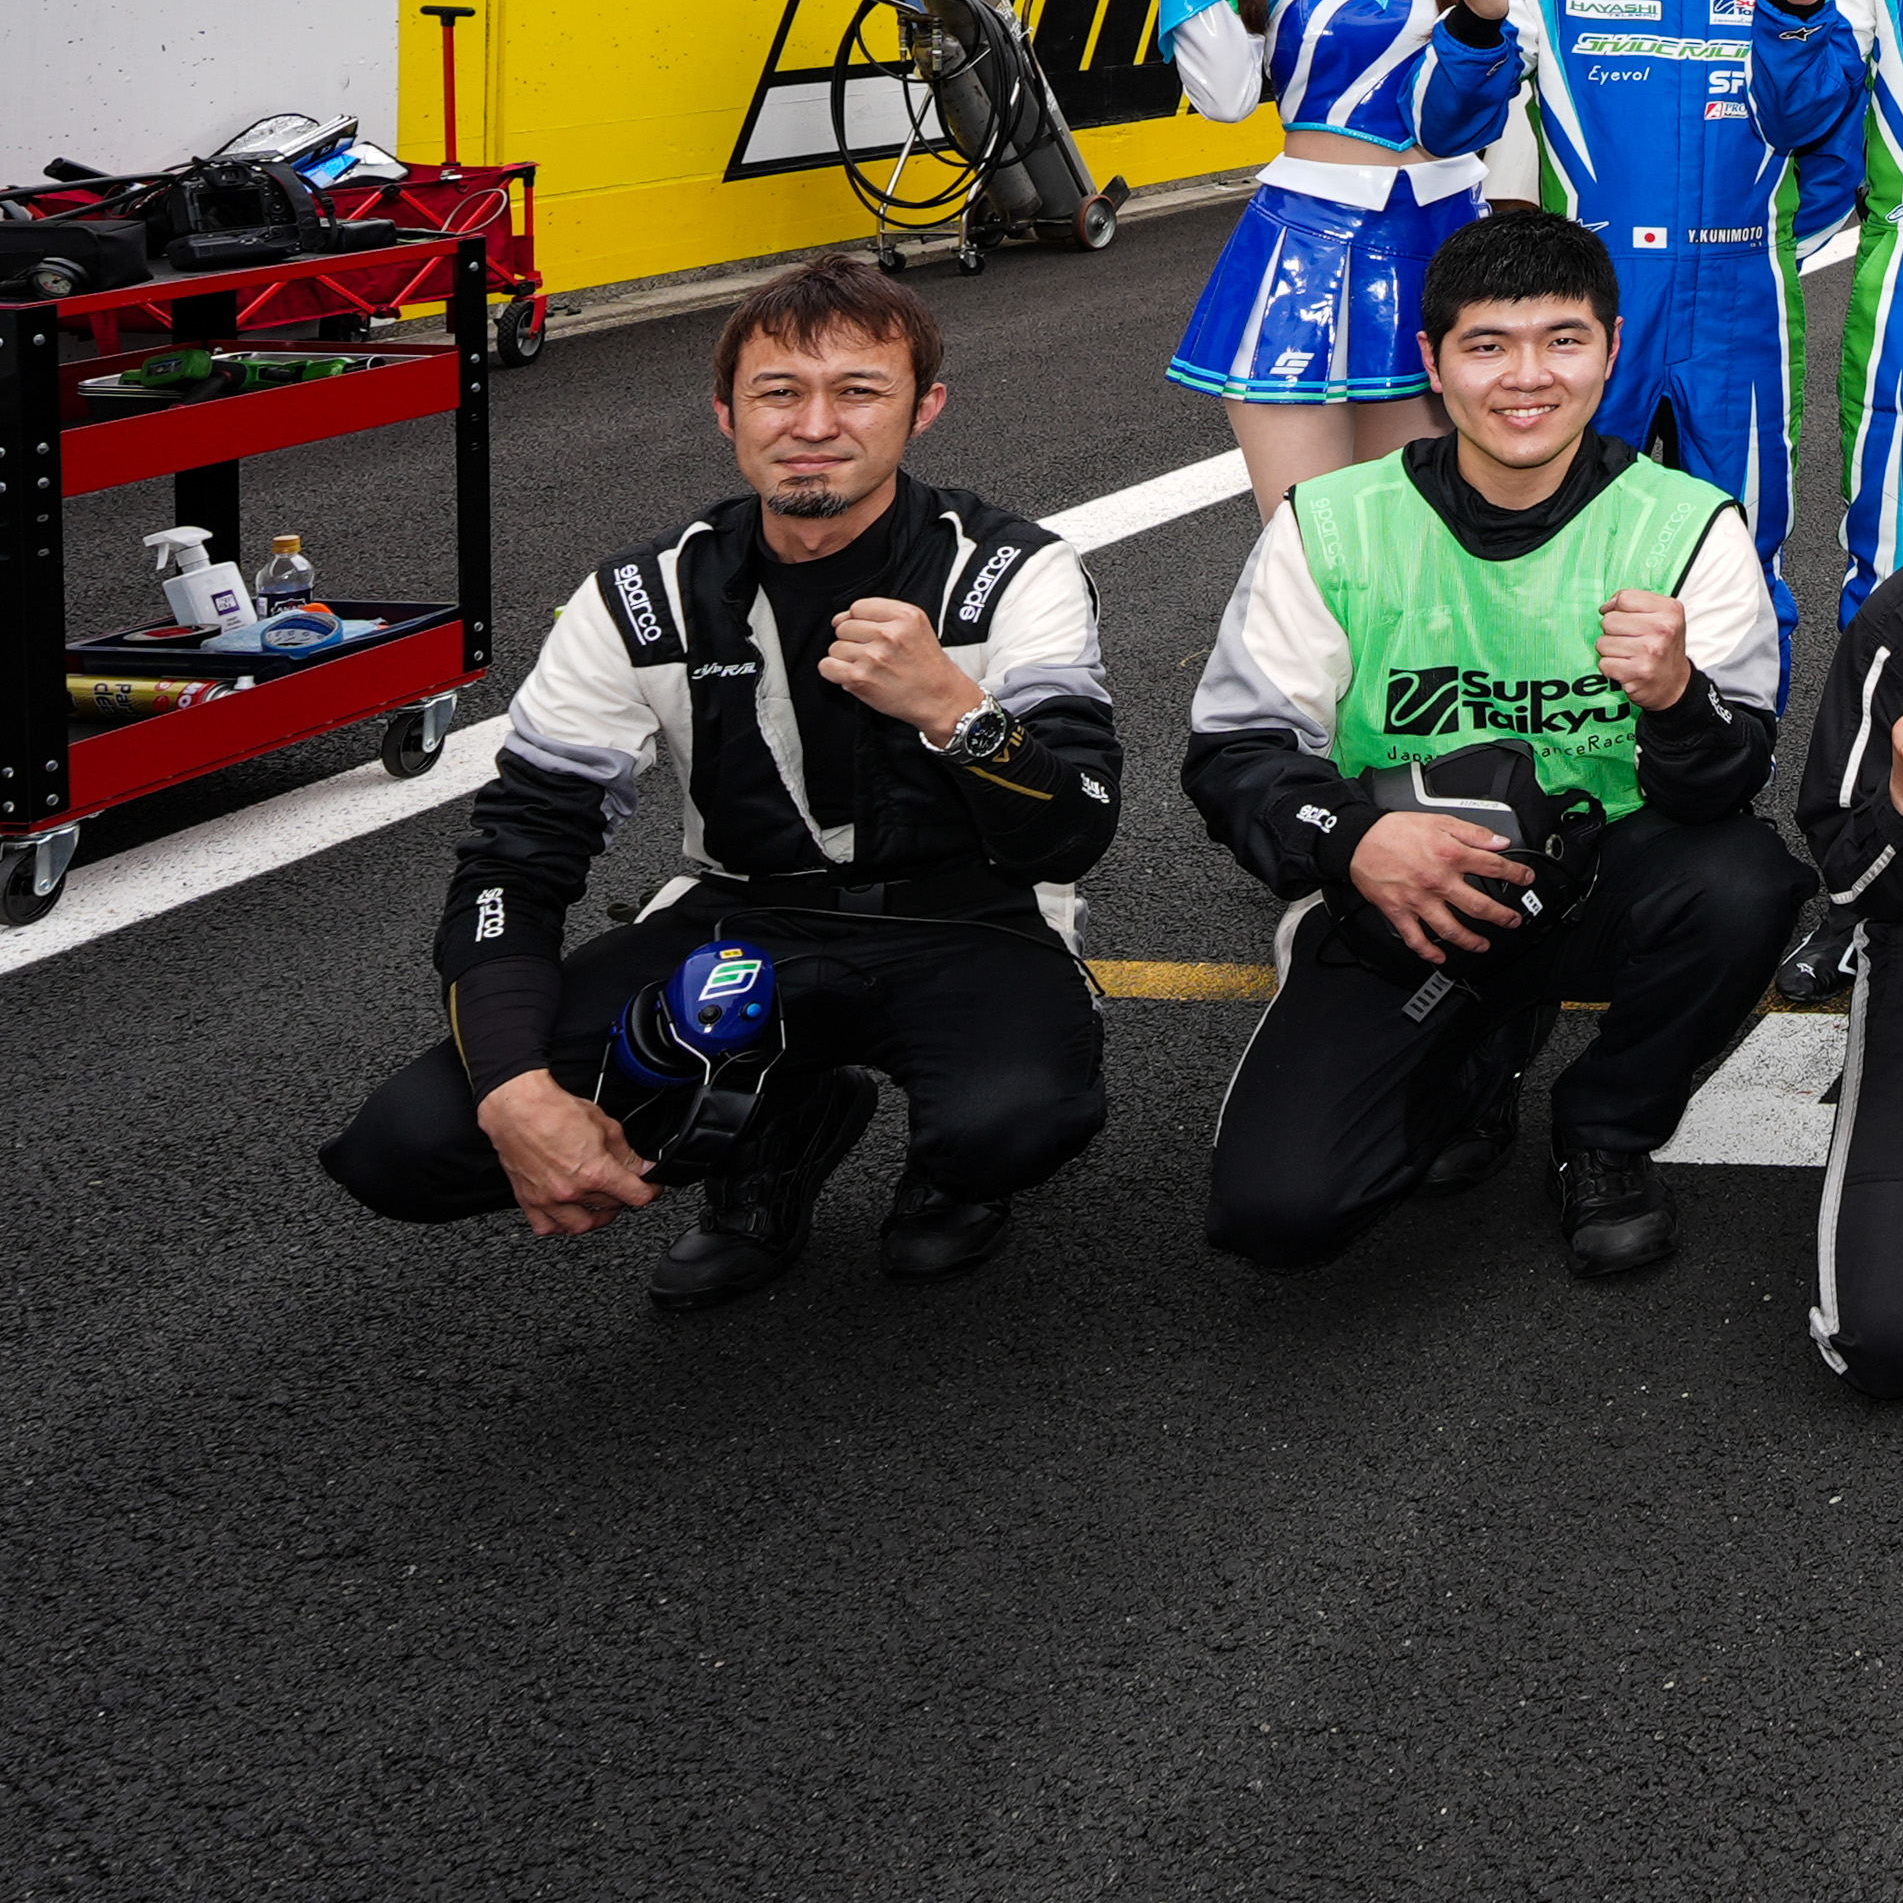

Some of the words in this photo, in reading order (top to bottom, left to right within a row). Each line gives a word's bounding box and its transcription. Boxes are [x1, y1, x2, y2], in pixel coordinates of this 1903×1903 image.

[1569, 0, 1658, 15] HAYASHI
[1573, 35, 1677, 58] SHADE
[1588, 65, 1651, 85] Eyevol
[1688, 226, 1763, 244] Y.KUNIMOTO
[1309, 497, 1346, 570] sparco
[1646, 501, 1697, 569] sparco
[959, 545, 1020, 623] sparco
[613, 563, 661, 646] sparco
[1463, 704, 1631, 735] Taikyu
